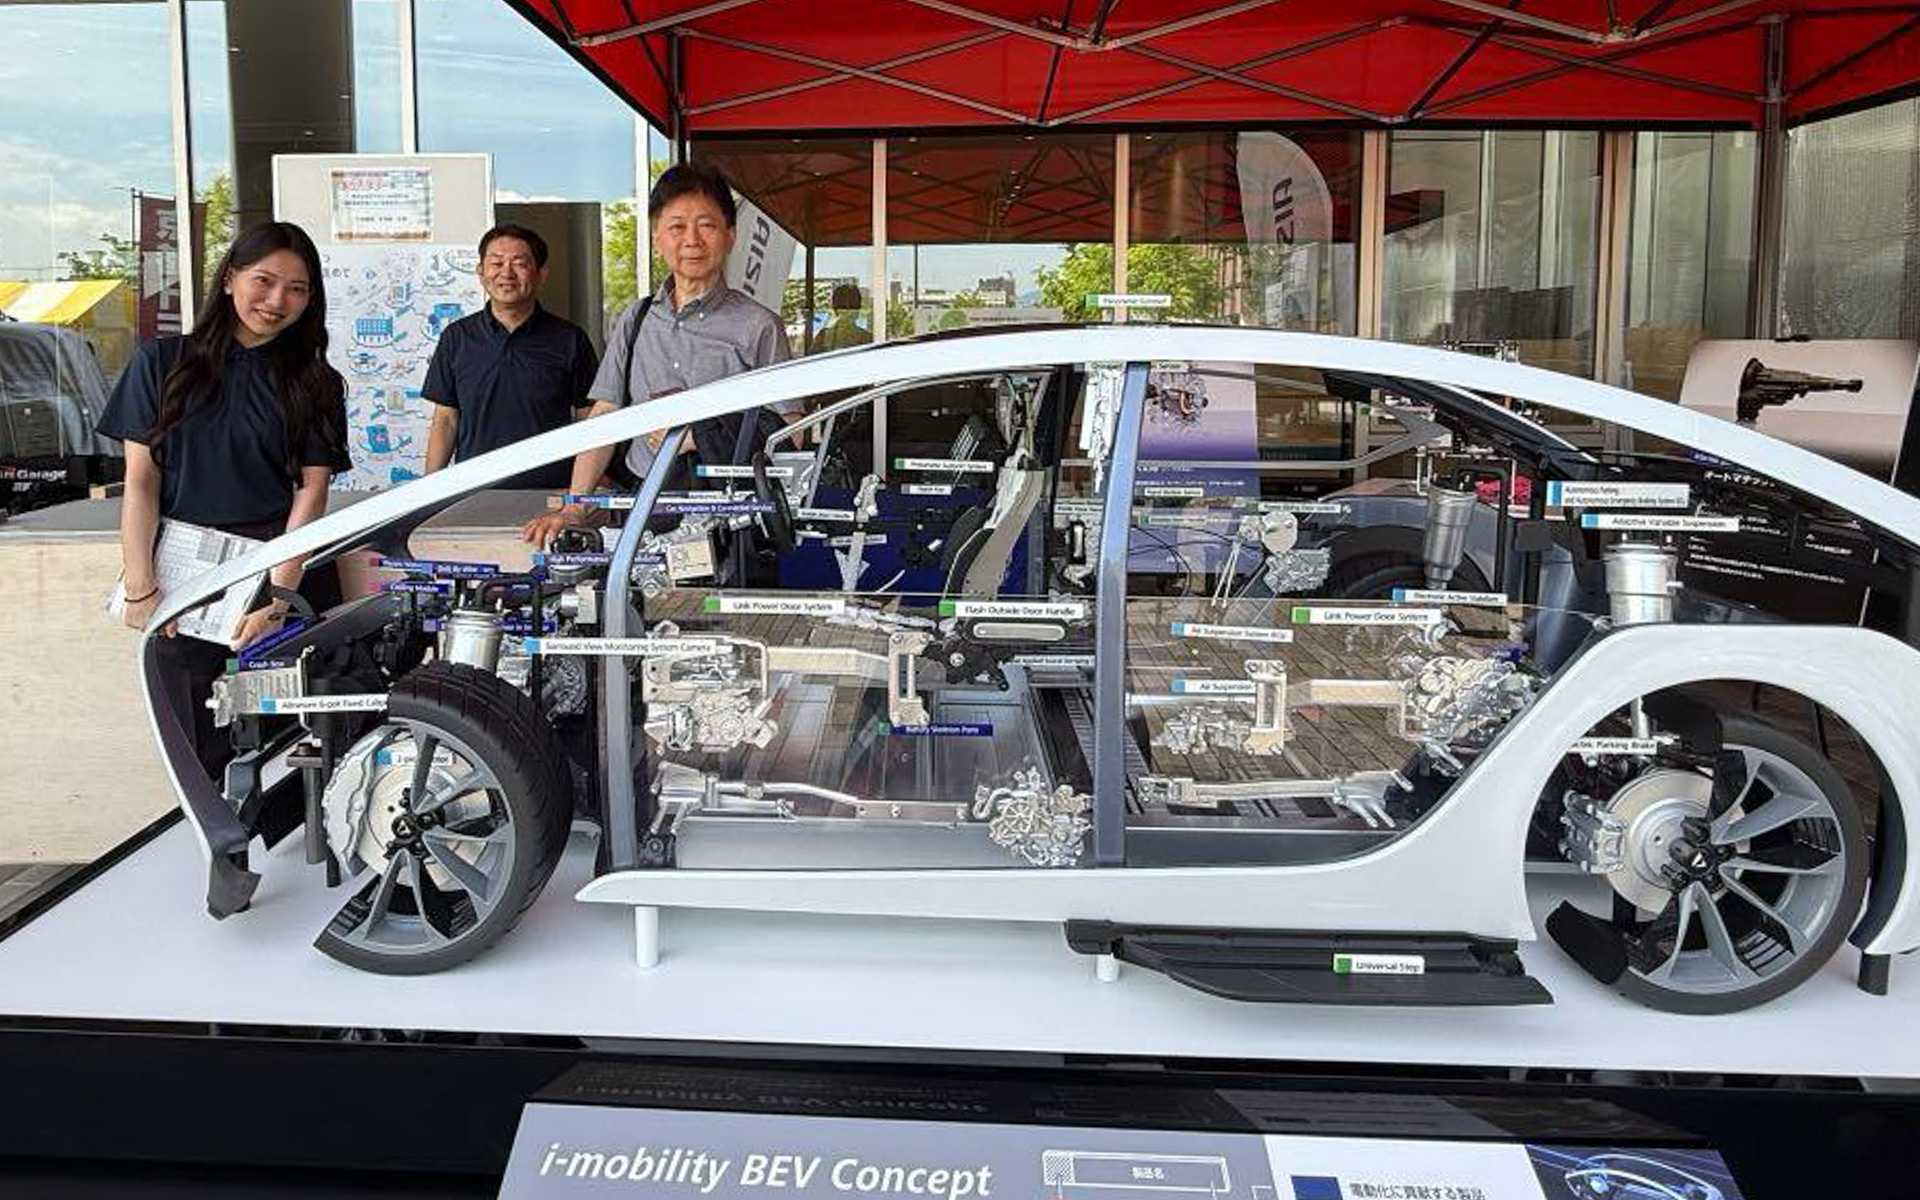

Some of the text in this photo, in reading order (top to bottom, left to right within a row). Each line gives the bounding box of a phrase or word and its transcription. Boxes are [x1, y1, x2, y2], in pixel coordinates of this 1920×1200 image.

[742, 216, 771, 297] AISI
[1612, 516, 1647, 527] Adaptive
[1649, 518, 1680, 527] Variable
[733, 601, 833, 613] Link Power Door System
[1022, 606, 1043, 615] Door
[1045, 607, 1076, 616] Handle
[1324, 609, 1429, 623] Link Power Door System
[546, 640, 712, 654] Surround View Monitoring System Camera
[1200, 682, 1211, 690] Air
[1596, 741, 1629, 751] Parking
[1631, 742, 1656, 750] Brake
[1356, 961, 1422, 973] Universal Step
[539, 1142, 994, 1200] i-mobility BEV Concept
